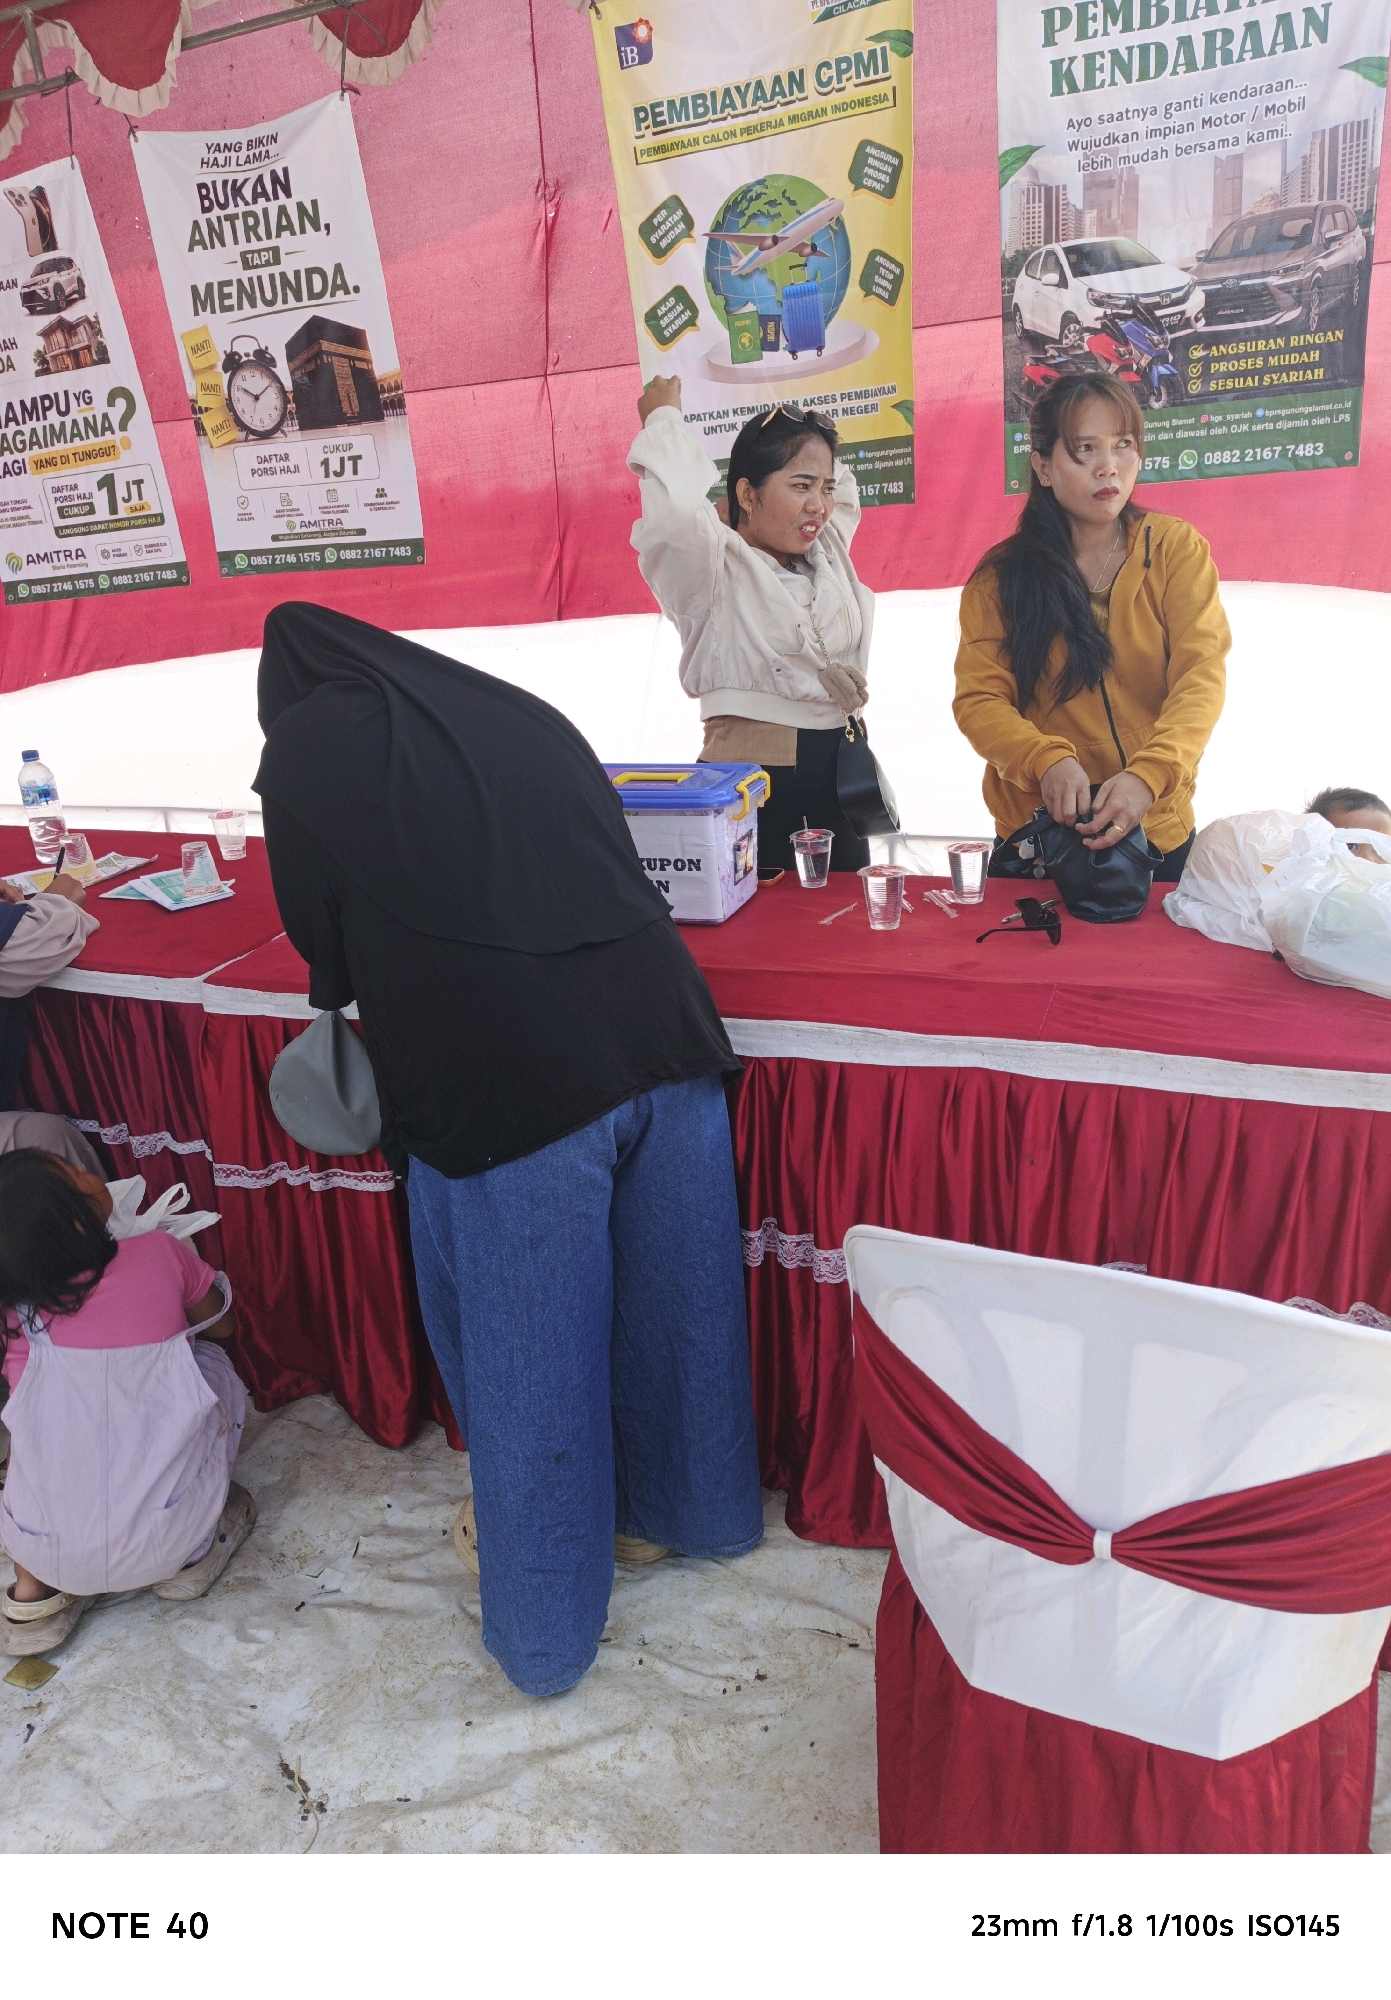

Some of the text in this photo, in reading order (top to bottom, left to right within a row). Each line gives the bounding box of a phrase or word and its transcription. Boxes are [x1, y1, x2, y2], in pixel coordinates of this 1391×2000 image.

[1050, 2, 1332, 97] KENDARAAN
[633, 45, 891, 135] PEMBIAYAAN CPMI
[1066, 78, 1308, 132] Ayo saatnya ganti kendaraan...
[640, 93, 890, 159] PEMBIAYAAN CALON PEKERJA MIGRAN INDONESIA
[1067, 96, 1306, 153] Wujudkan impian Motor / Mobil
[205, 132, 278, 155] YANG BIKIN
[1078, 127, 1292, 173] lebih mudah bersama kami..
[200, 150, 280, 169] HAJI LAMA...
[865, 146, 899, 166] ANGSURAN
[868, 157, 892, 173] RINGAN
[863, 167, 890, 183] PROSES
[863, 178, 885, 191] CEPAT
[196, 166, 293, 214] BUKAN
[187, 199, 331, 252] ANTRIAN,
[650, 209, 684, 244] SYARATAN
[653, 209, 667, 226] PER
[660, 221, 685, 249] MUDAH
[246, 251, 274, 266] TAPI
[190, 262, 361, 317] MENUNDA.
[657, 297, 676, 317] AKAD
[660, 303, 684, 327] SESUAI
[664, 309, 692, 338] SYARIAH
[190, 339, 212, 353] NANTI
[1209, 329, 1344, 357] ANGSURAN RINGAN
[1210, 350, 1320, 373] PROSES MUDAH
[200, 384, 221, 394] NANTI
[1209, 368, 1325, 392] SESUAI SYARIAH
[803, 394, 837, 408] AKSES
[840, 384, 897, 402] PEMBIAYAAN
[0, 389, 93, 429] AMPU YG
[703, 422, 739, 435] UNTUK
[842, 403, 879, 417] NEGERI
[211, 419, 232, 435] NANTI
[1144, 420, 1169, 429] Gunung
[1172, 417, 1195, 426] Slamet
[1158, 432, 1173, 440] dan
[1176, 428, 1207, 439] diawasi
[1210, 426, 1228, 436] oleh
[1231, 424, 1249, 433] OJK
[1252, 423, 1274, 431] serta
[1276, 419, 1308, 430] dijamin
[1311, 416, 1330, 426] oleh
[1333, 414, 1351, 424] LPS
[257, 453, 290, 465] DAFTAR
[322, 443, 354, 455] CUKUP
[1204, 450, 1240, 465] 0882
[1244, 446, 1282, 462] 2167
[1286, 443, 1324, 458] 7483
[0, 445, 116, 480] AGI YANG DI TUNGGU?
[251, 464, 300, 477] PORSI HAJI
[320, 455, 363, 479] 1JT
[857, 463, 873, 471] serta
[51, 483, 79, 495] DAFTAR
[54, 492, 94, 504] PORSI HAJI
[882, 481, 904, 494] 7483
[63, 505, 90, 516] CUKUP
[129, 504, 146, 513] SAJA
[300, 518, 343, 529] AMITRA
[26, 548, 86, 566] AMITRA
[251, 546, 411, 565] 0857 2746 1575 0882 2167 7483
[32, 570, 177, 594] 0857 2746 1575 0882 2167 7483
